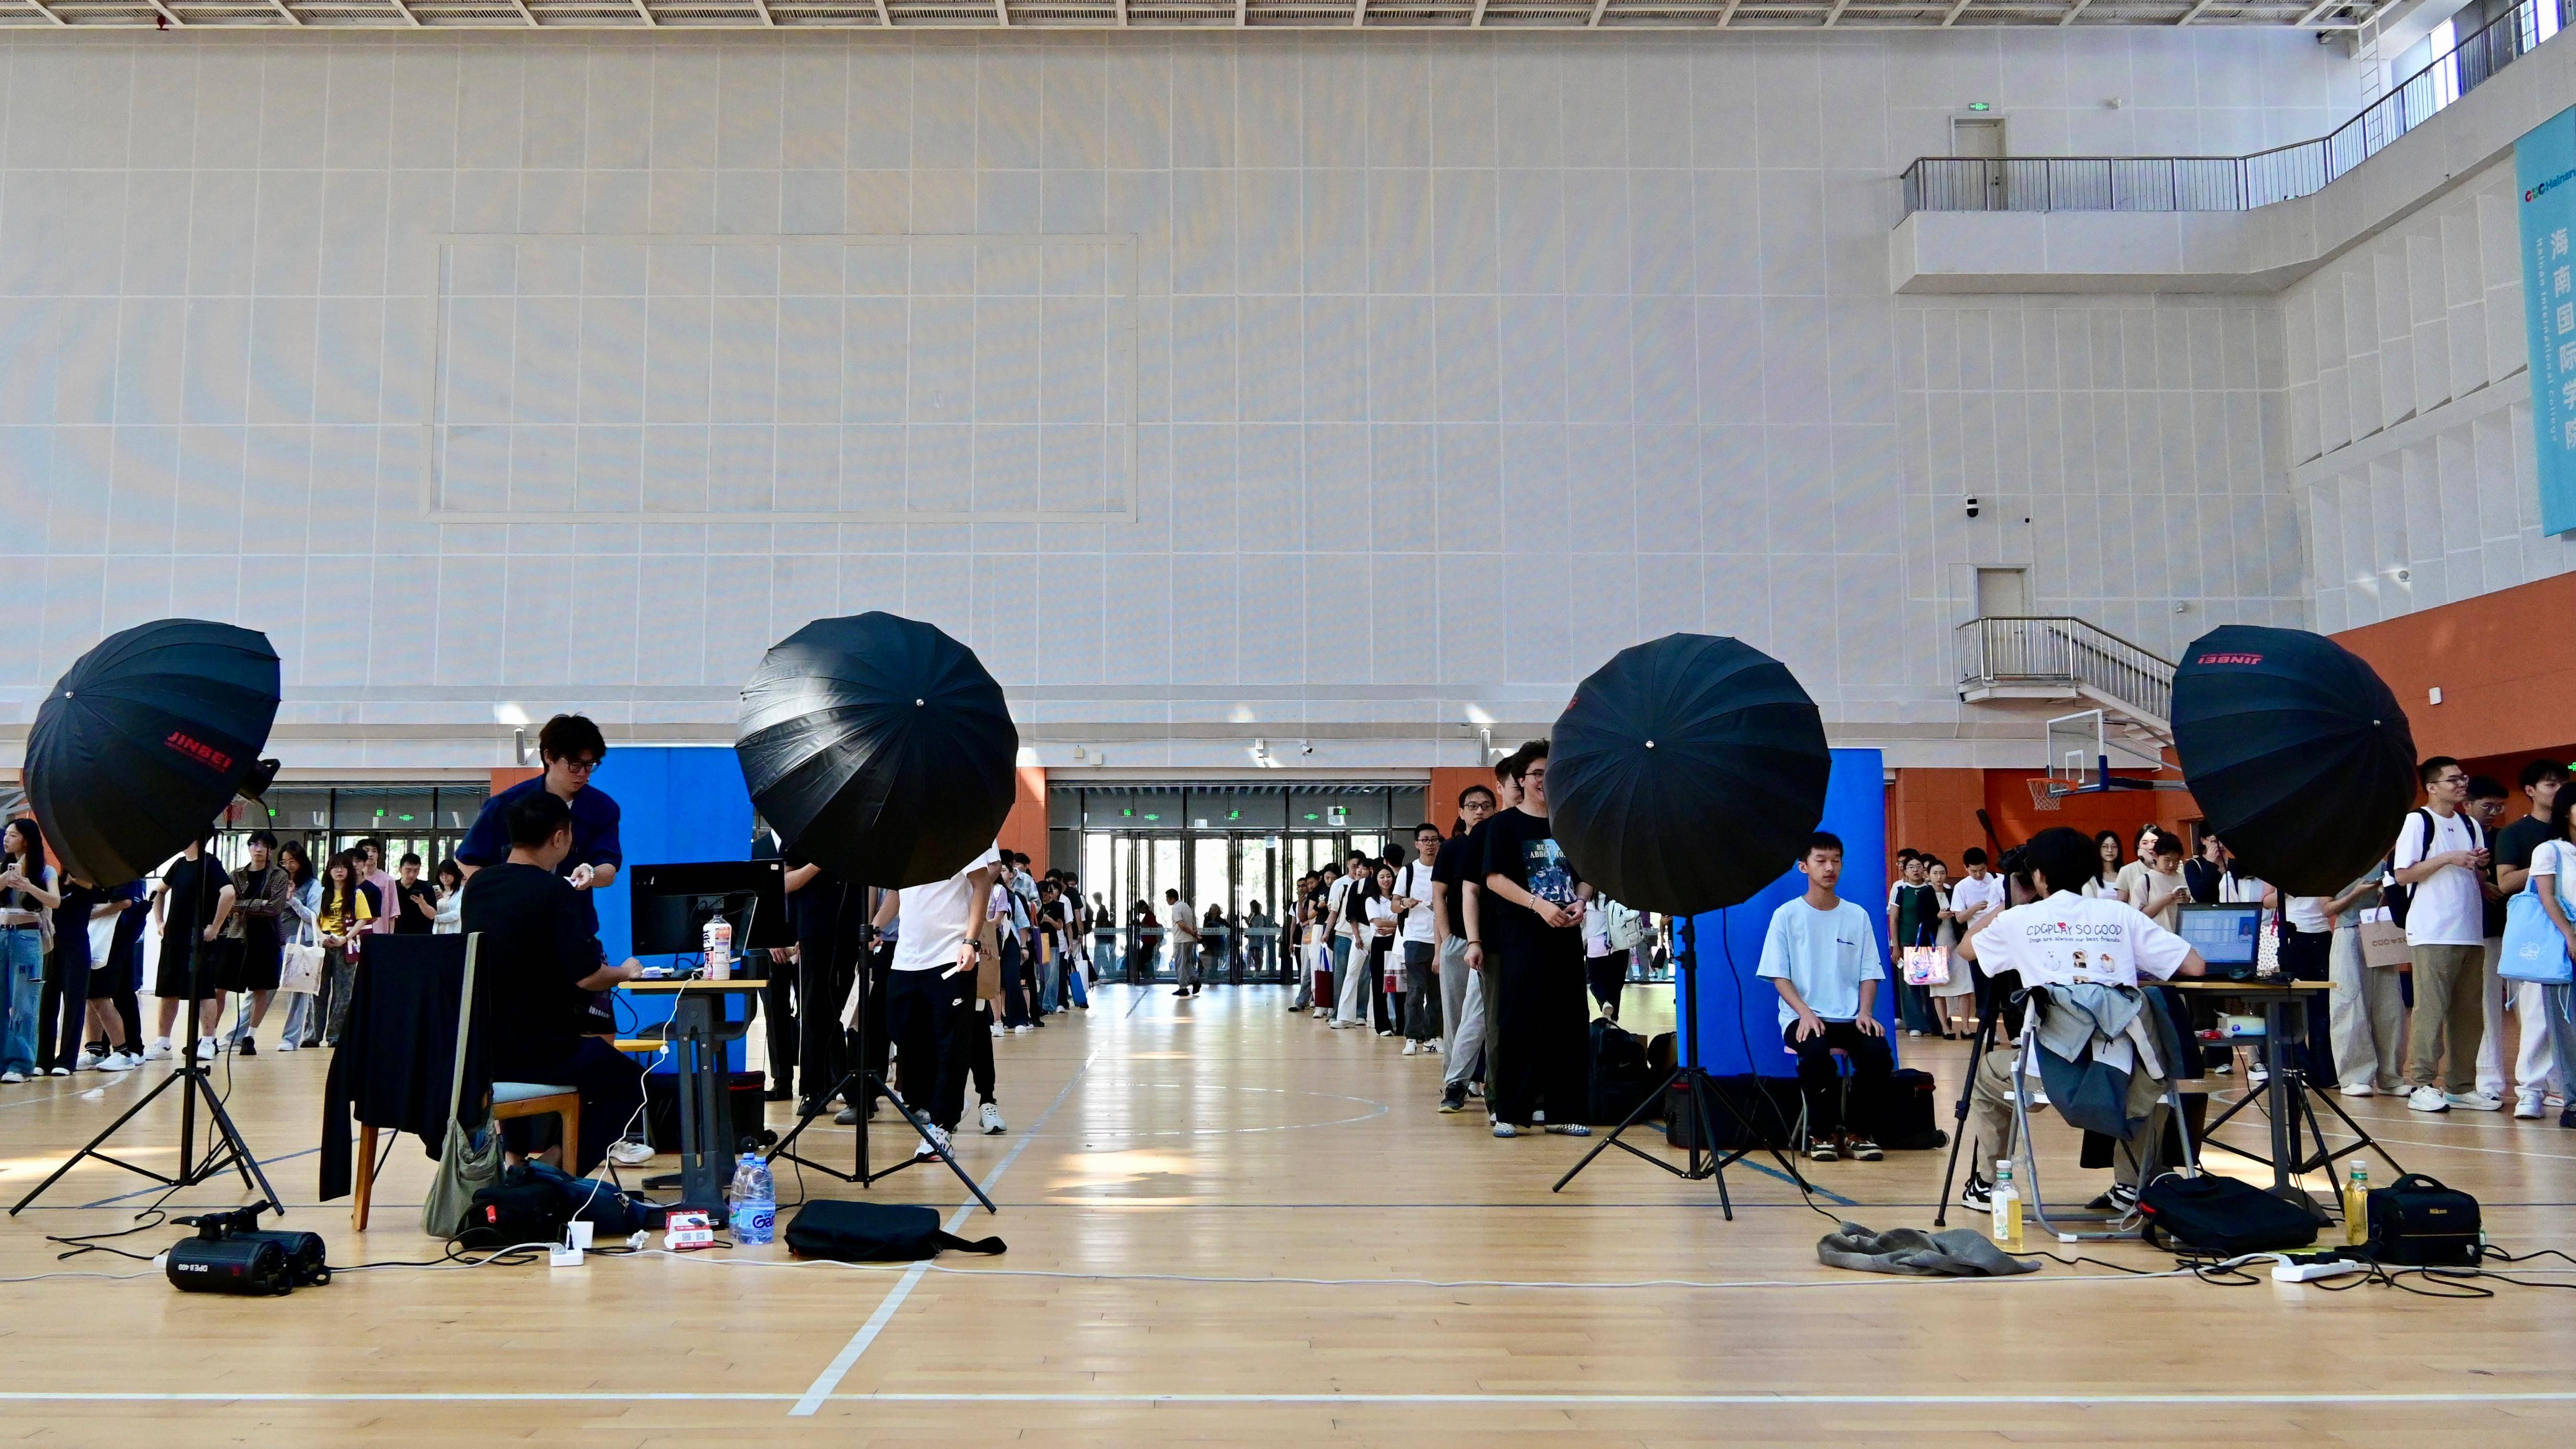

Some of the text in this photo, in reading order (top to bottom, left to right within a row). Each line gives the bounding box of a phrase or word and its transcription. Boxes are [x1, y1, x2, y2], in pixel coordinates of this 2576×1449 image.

[2198, 655, 2261, 665] JINBEI
[167, 731, 231, 768] JINBEI
[2076, 924, 2091, 935] SO
[2095, 924, 2122, 935] GOOD
